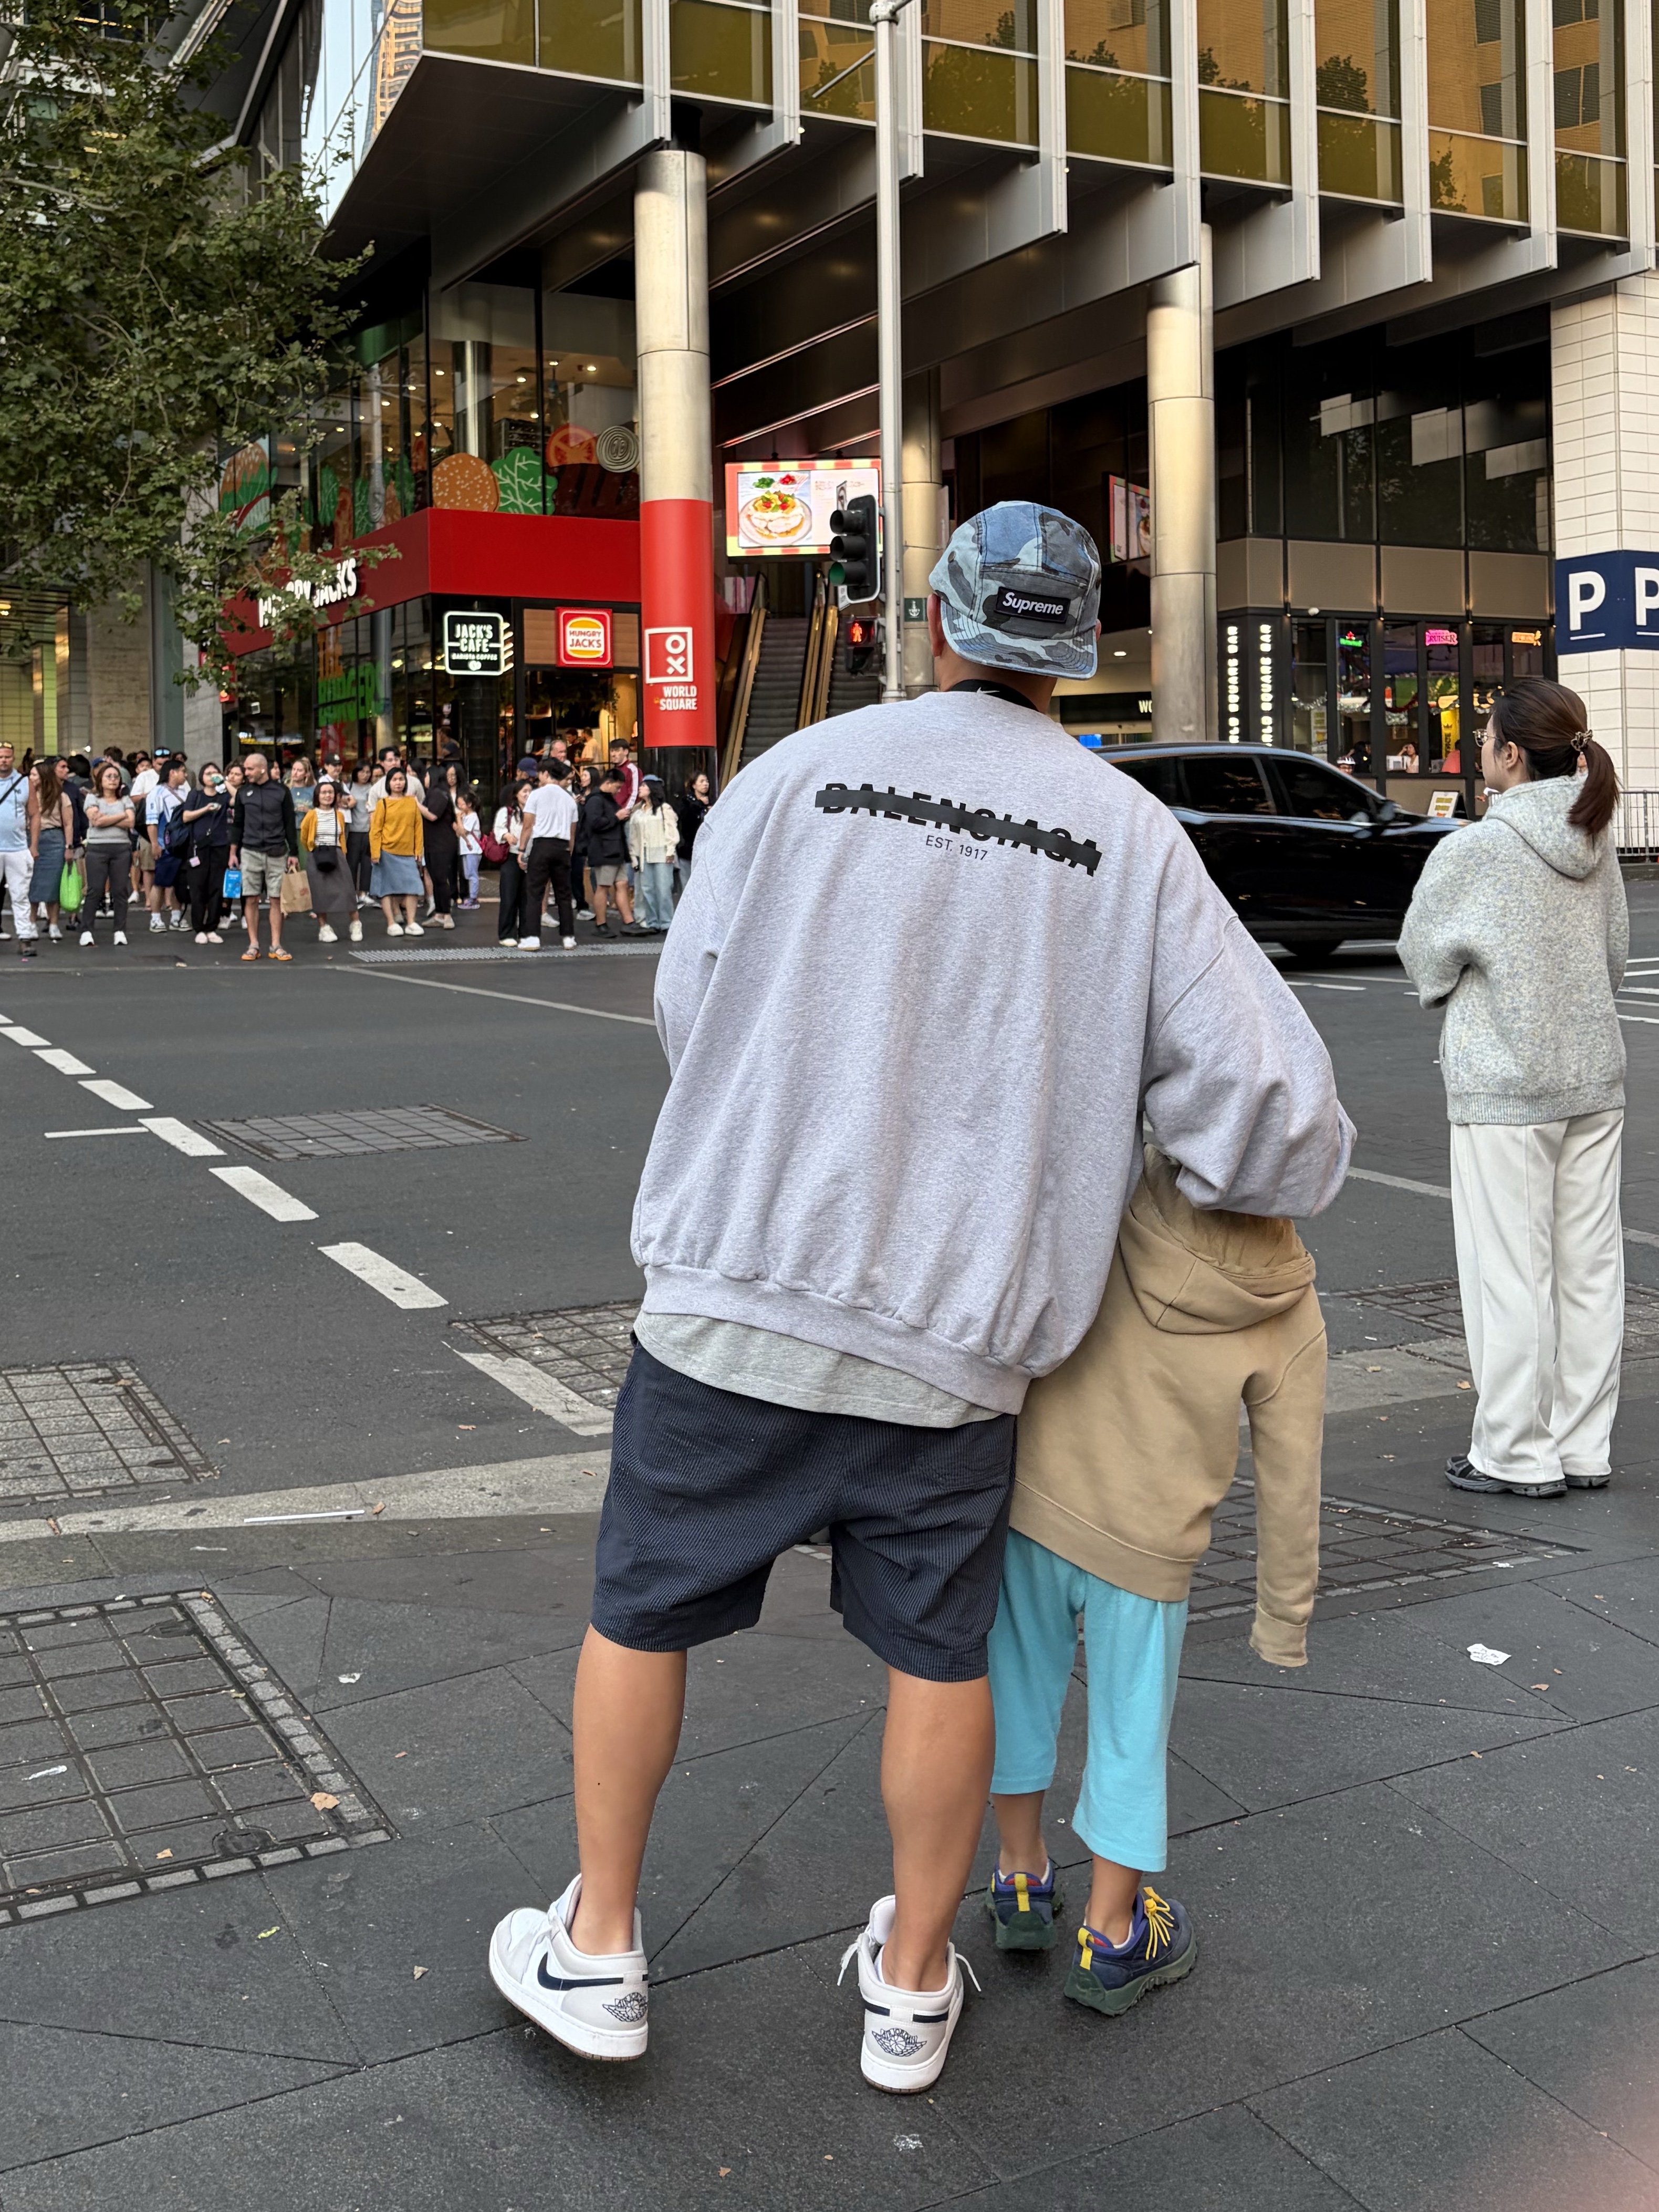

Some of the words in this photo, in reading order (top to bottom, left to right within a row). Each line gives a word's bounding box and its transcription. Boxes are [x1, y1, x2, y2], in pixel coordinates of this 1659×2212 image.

[1002, 591, 1063, 615] Supreme
[1568, 570, 1606, 631] P
[1634, 567, 1659, 626] P
[454, 623, 493, 639] JACK'S
[1227, 626, 1238, 654] BAR
[1260, 624, 1271, 652] BAR
[460, 638, 489, 652] CAFE
[663, 686, 697, 698] WORLD
[1228, 658, 1239, 712] SQUARE
[1260, 657, 1273, 711] SQUARE
[660, 698, 697, 711] SQUARE
[926, 835, 953, 851] EST.
[959, 844, 988, 860] 1917
